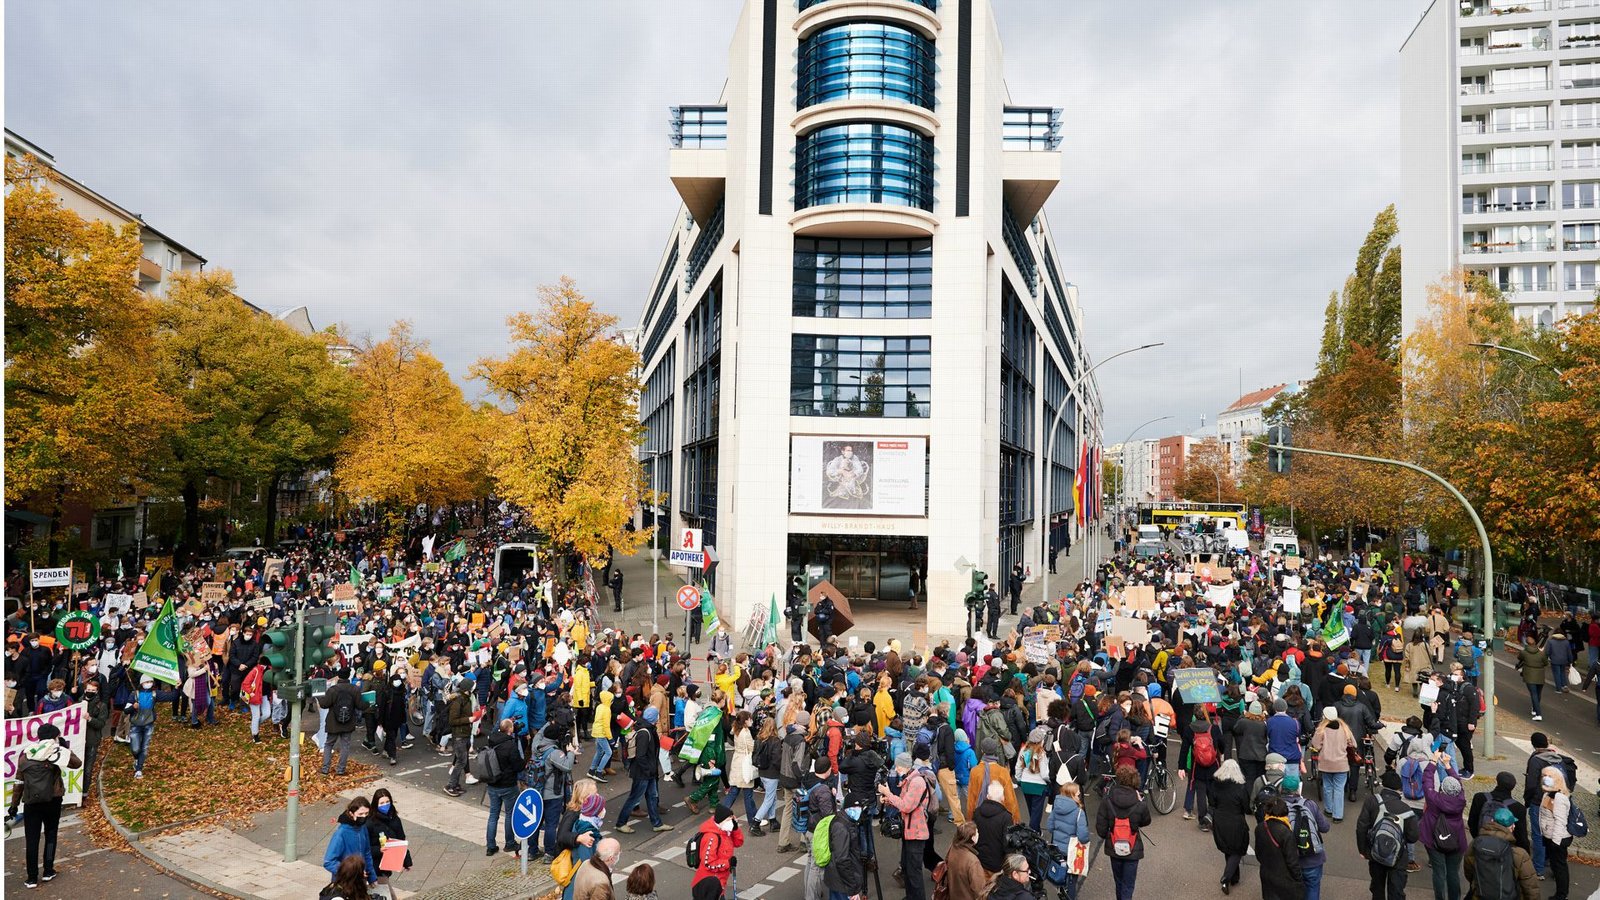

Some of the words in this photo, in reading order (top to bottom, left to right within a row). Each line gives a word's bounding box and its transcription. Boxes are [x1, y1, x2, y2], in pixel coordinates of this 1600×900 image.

[671, 551, 704, 562] APOTHEKE
[33, 570, 69, 579] SPENDEN
[57, 611, 77, 629] FRIDAYS
[80, 611, 94, 620] FOR
[71, 635, 98, 649] FUTURE
